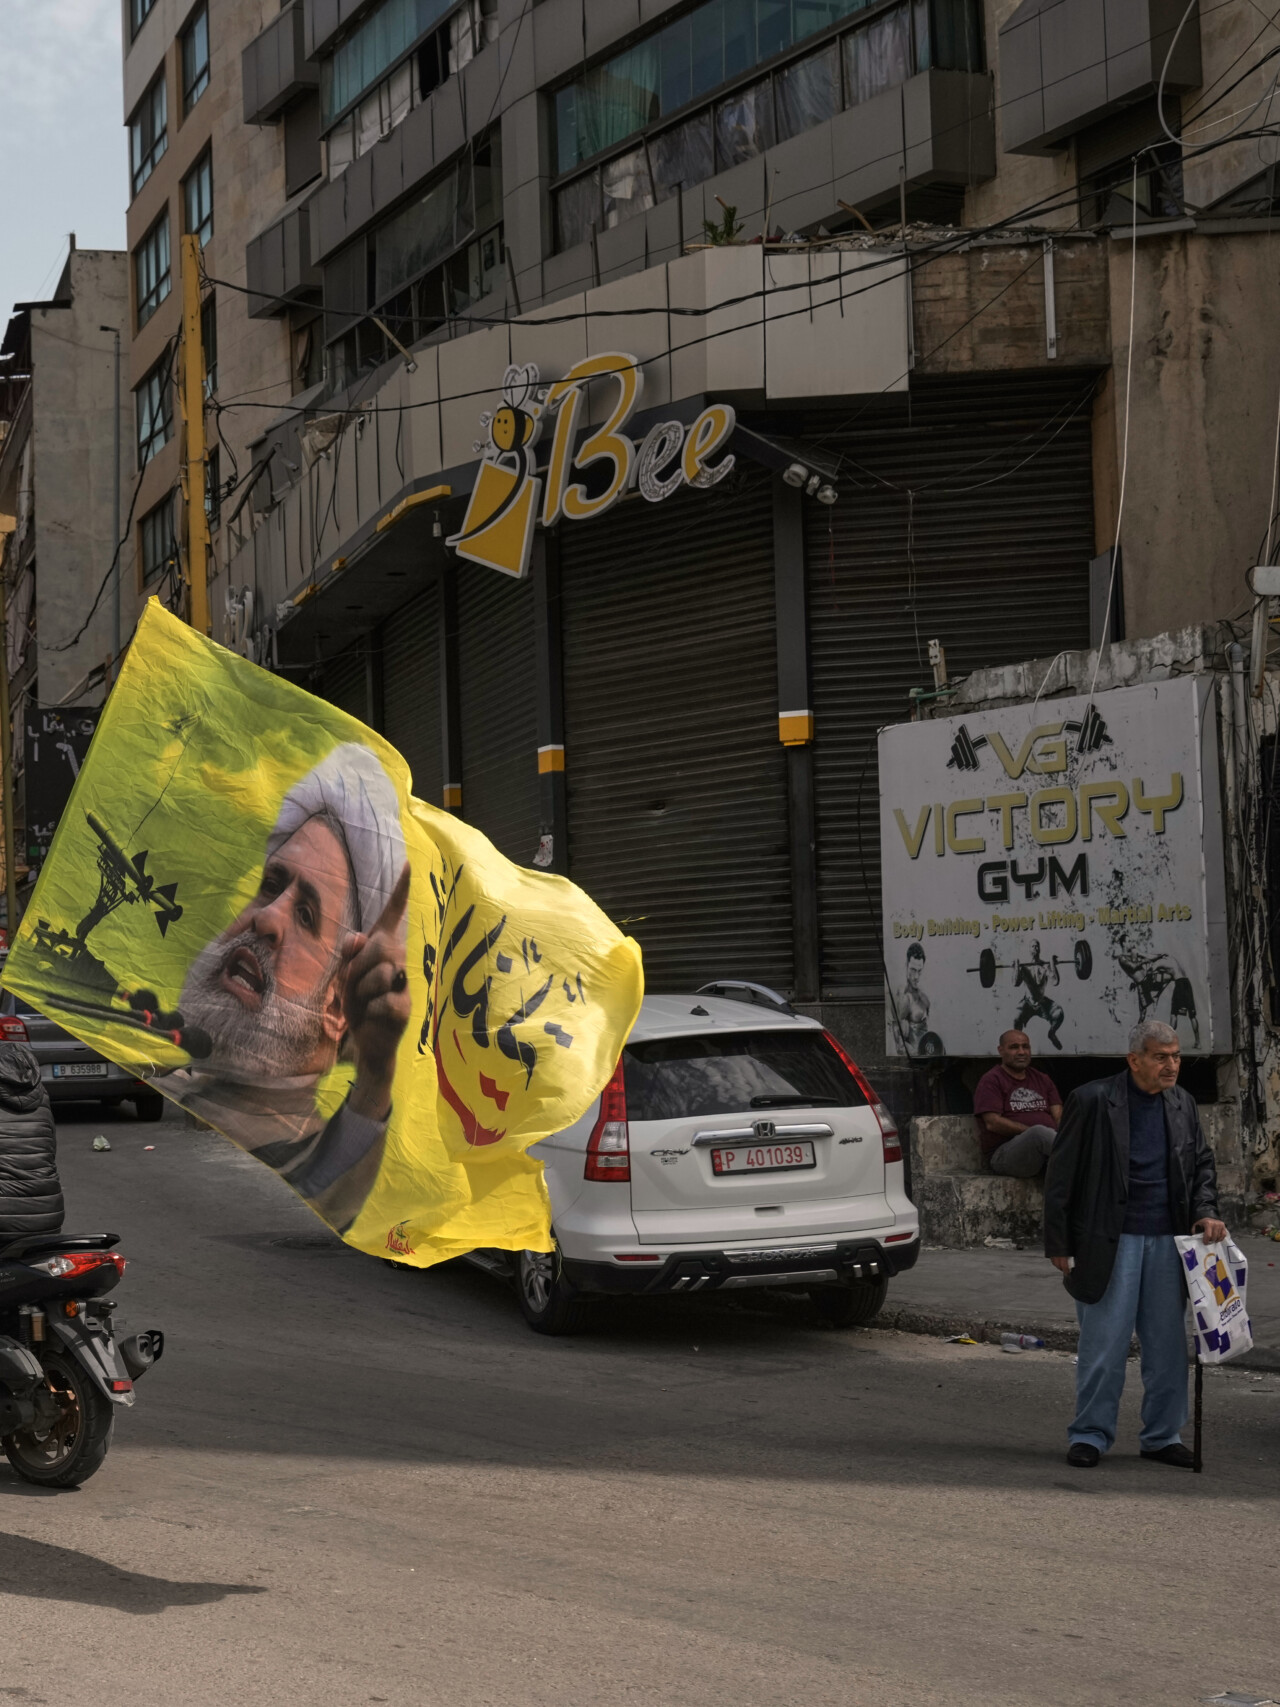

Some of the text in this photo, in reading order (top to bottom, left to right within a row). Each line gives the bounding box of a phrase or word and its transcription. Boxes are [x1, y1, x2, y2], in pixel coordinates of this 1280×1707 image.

[893, 772, 1184, 860] VICTORY
[977, 852, 1089, 902] GYM
[893, 921, 924, 941] Body
[927, 917, 980, 938] Building
[992, 914, 1035, 933] Power
[1038, 910, 1085, 932] Lifting
[1098, 905, 1153, 925] Martial
[1157, 903, 1192, 923] Arts
[725, 1146, 803, 1169] P 401039
